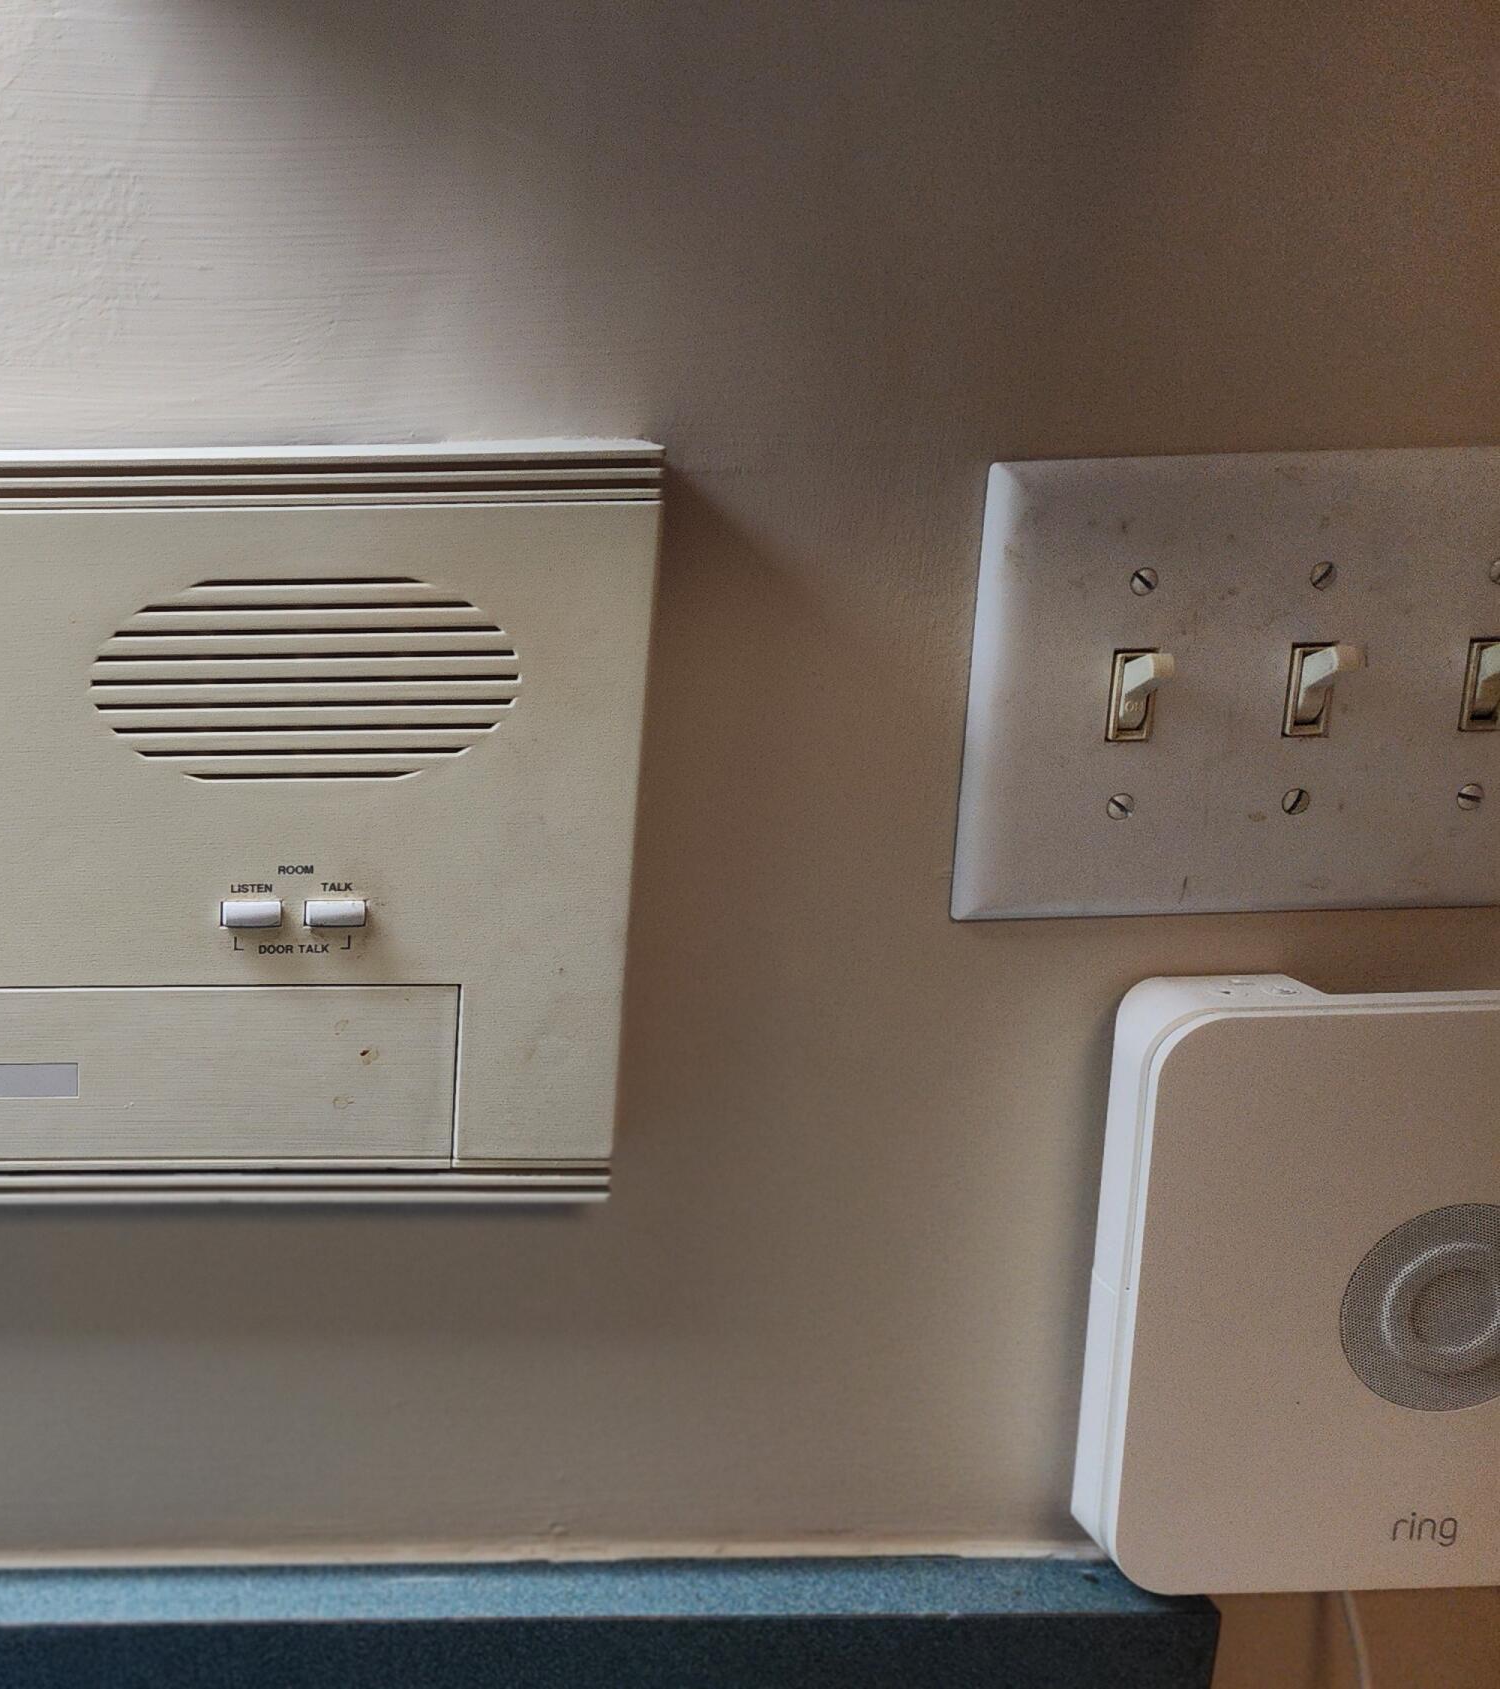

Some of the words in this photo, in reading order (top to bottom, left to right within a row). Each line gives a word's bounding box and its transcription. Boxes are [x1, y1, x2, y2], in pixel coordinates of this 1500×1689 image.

[277, 865, 314, 875] ROOM
[230, 883, 273, 893] LISTEN
[321, 882, 352, 892] TALK
[258, 944, 294, 955] DOOR
[299, 943, 330, 954] TALK
[1392, 1511, 1458, 1547] ring
